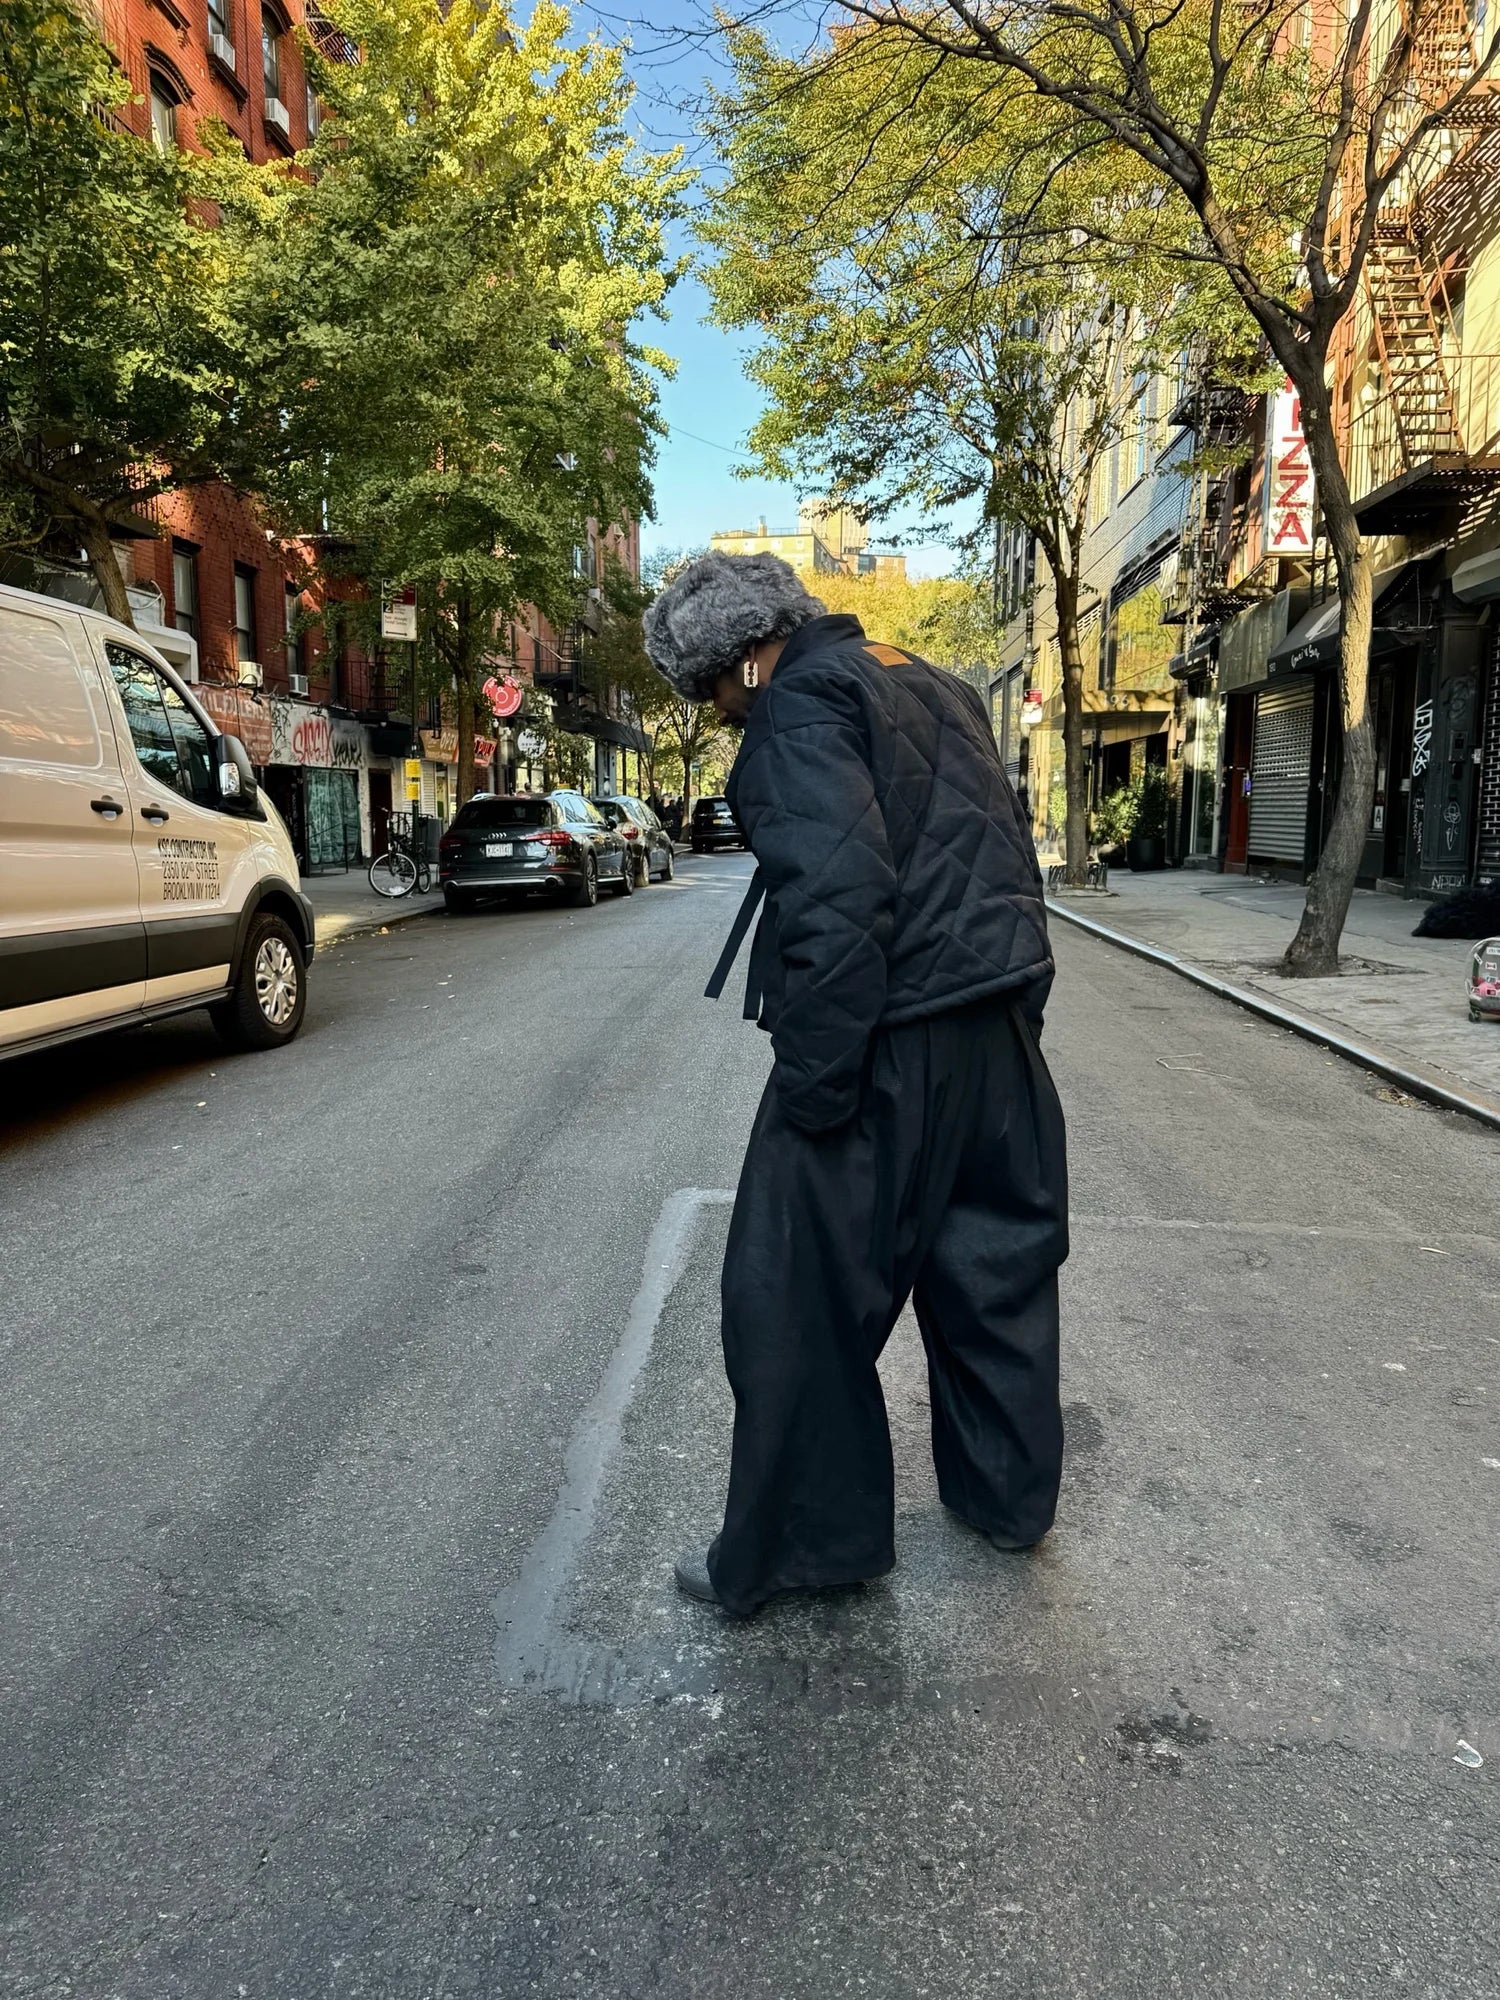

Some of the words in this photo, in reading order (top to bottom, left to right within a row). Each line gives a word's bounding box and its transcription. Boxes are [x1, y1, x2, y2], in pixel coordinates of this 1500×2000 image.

[196, 862, 218, 880] STREET
[163, 882, 195, 900] BROOKLYN
[196, 882, 205, 900] NY
[205, 883, 220, 900] 11214
